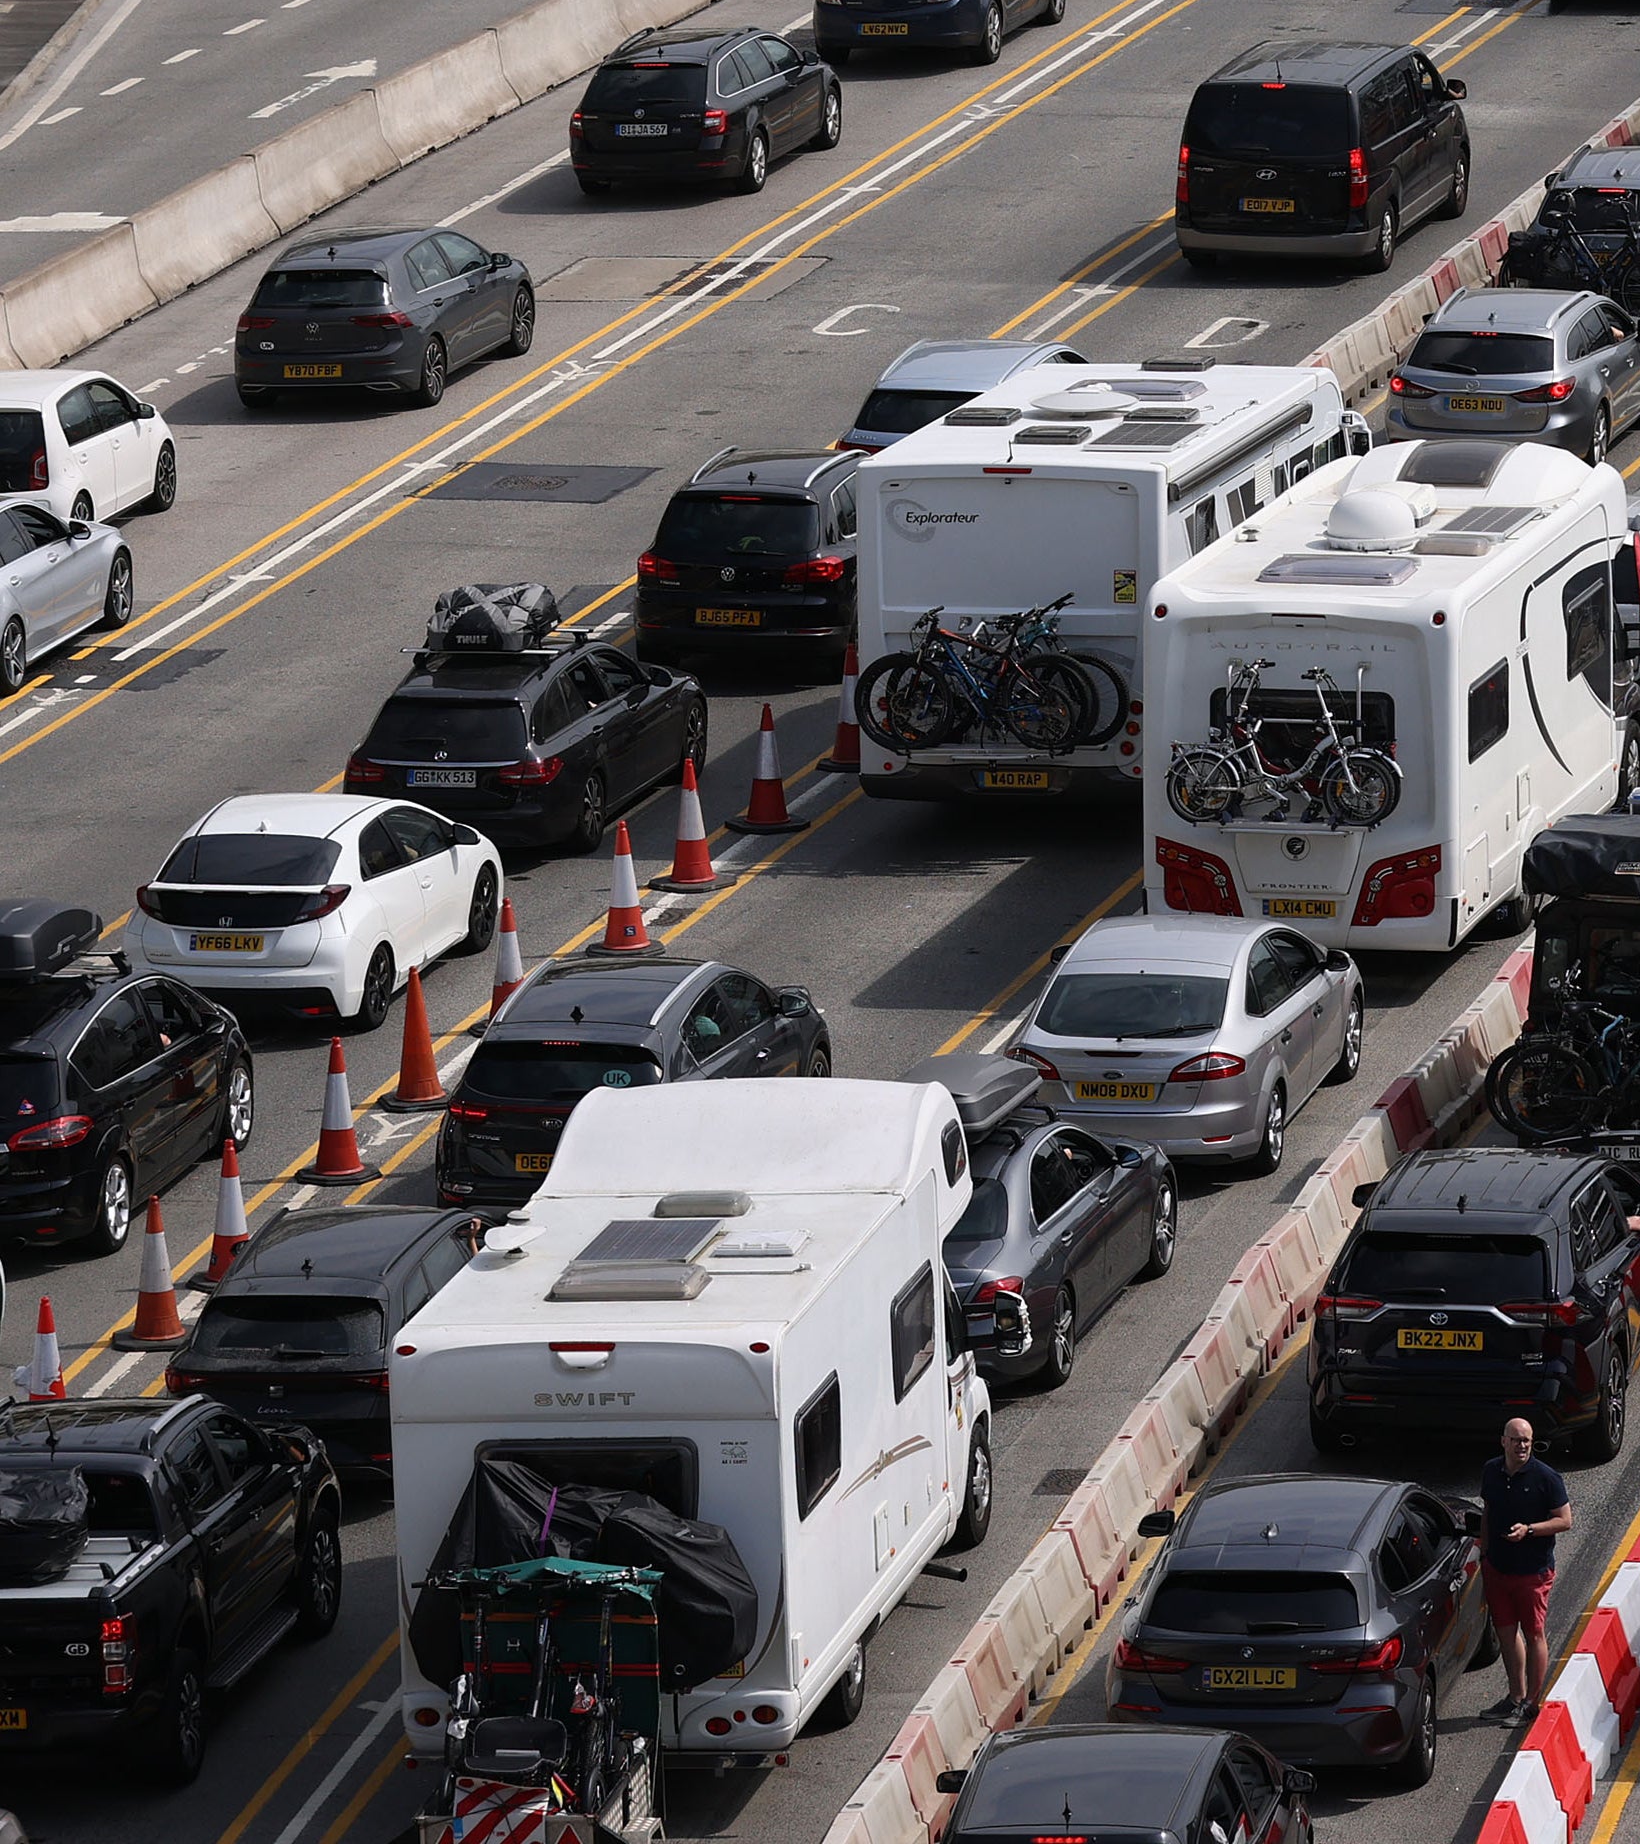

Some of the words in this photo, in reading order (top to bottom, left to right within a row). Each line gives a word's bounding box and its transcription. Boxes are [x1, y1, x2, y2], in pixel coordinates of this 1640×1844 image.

[811, 304, 901, 336] C
[1183, 317, 1269, 349] D
[905, 511, 979, 527] Explorateur
[732, 610, 759, 626] PFA
[413, 770, 432, 785] GG
[436, 770, 453, 785] KK
[454, 770, 475, 785] 513
[1011, 772, 1042, 788] RAP
[1271, 900, 1304, 916] LX14
[1306, 900, 1334, 916] CMU
[197, 934, 230, 950] YF66
[233, 935, 260, 951] LKV
[603, 1070, 629, 1086] UK
[1079, 1084, 1112, 1100] NM08
[1115, 1084, 1149, 1100] DXU
[1402, 1331, 1442, 1348] BK22
[1444, 1332, 1477, 1349] JNX
[533, 1391, 637, 1408] SWIFT
[1212, 1668, 1251, 1686] GX21
[1254, 1668, 1286, 1687] LJC
